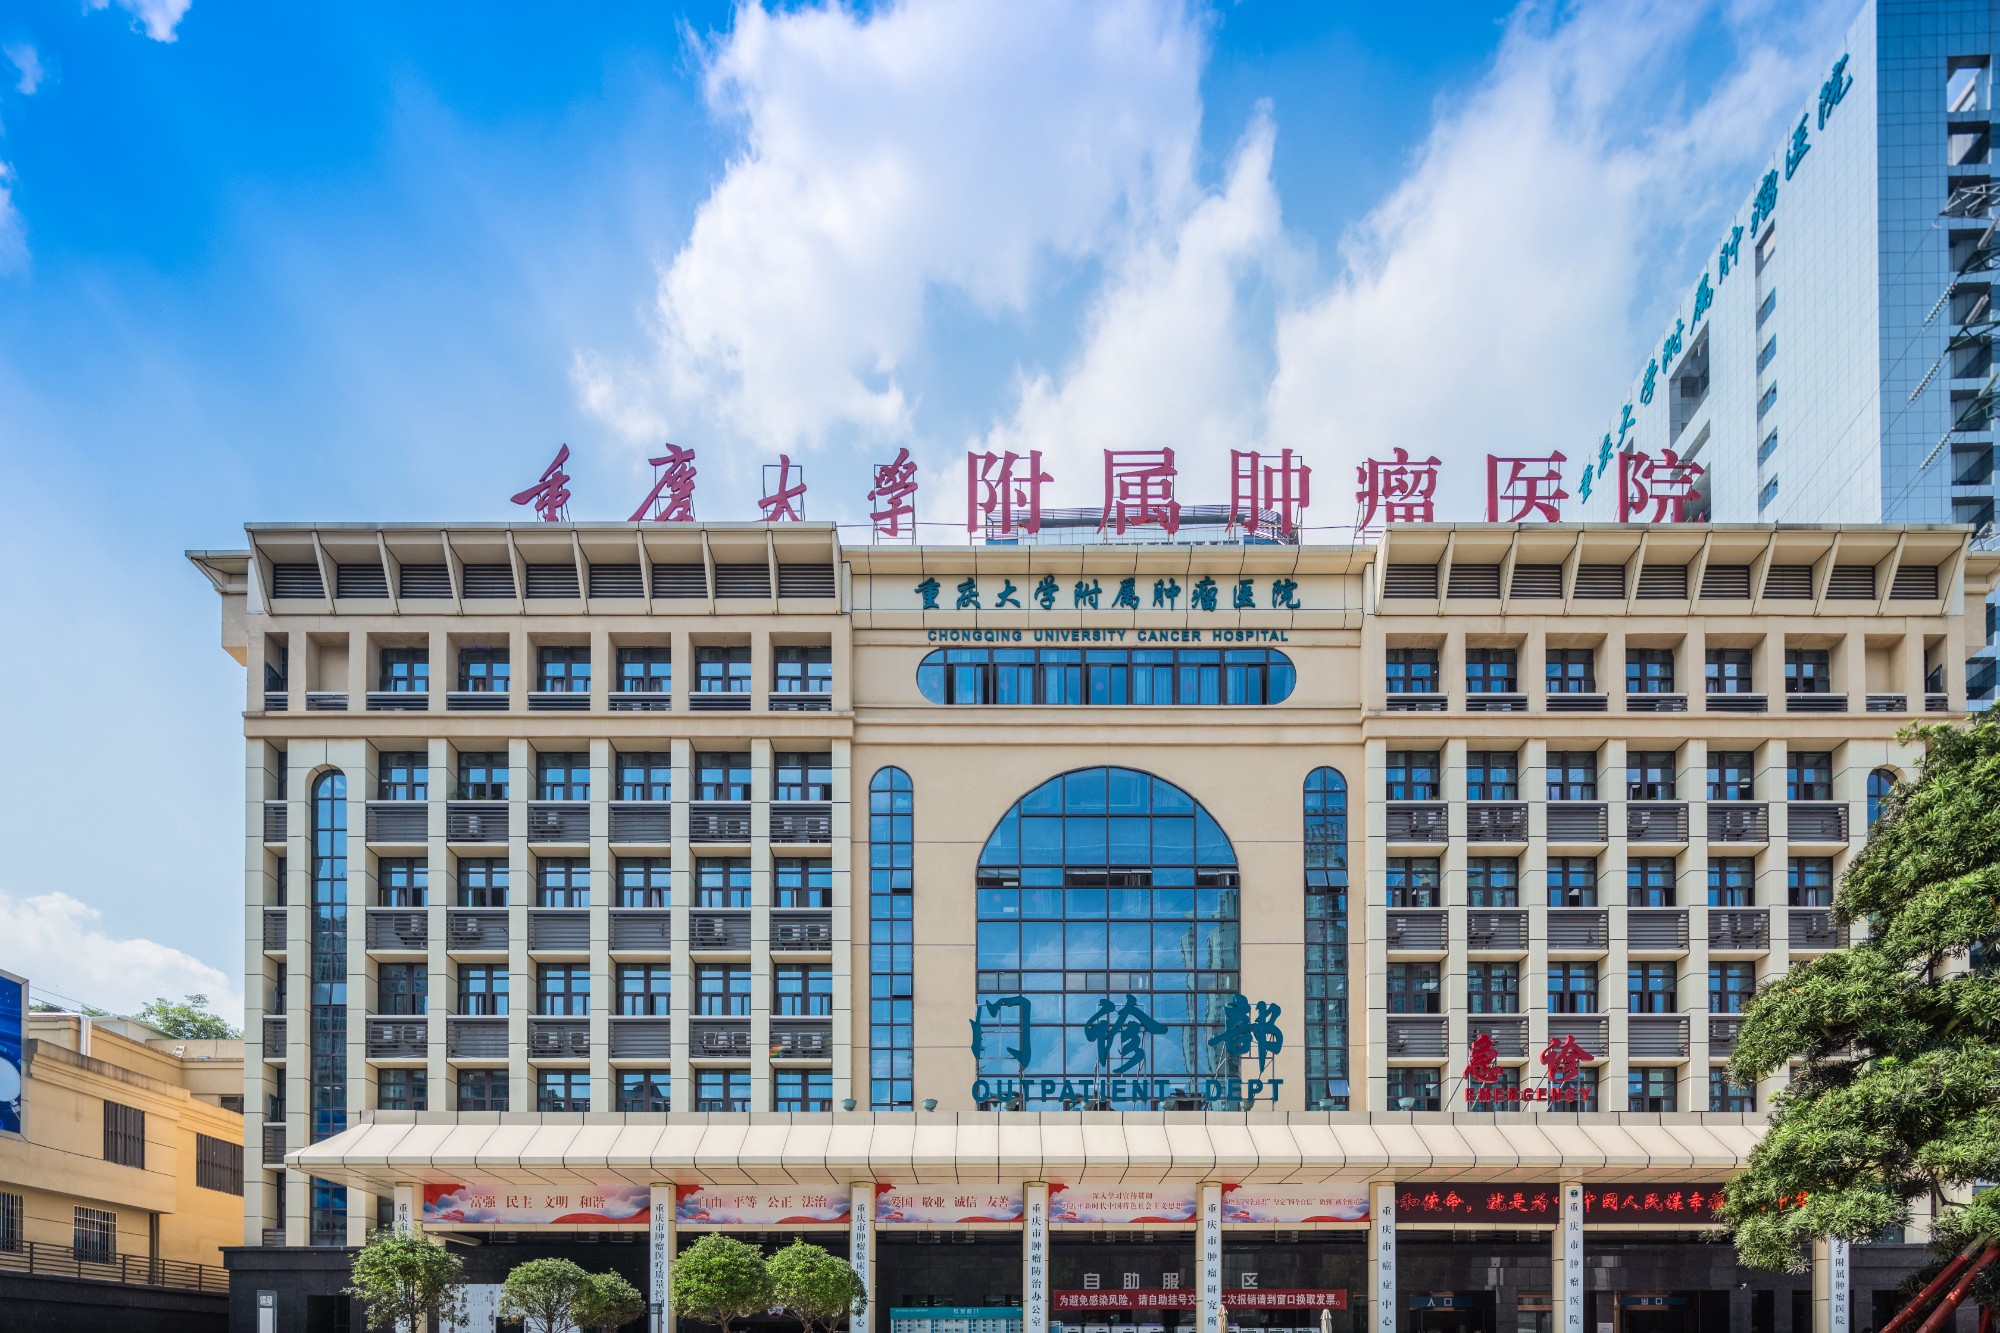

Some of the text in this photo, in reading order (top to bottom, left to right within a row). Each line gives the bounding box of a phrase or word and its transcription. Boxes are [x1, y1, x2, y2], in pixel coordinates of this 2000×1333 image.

[914, 574, 1301, 612] 重庆大学附属肿瘤医院
[927, 629, 1289, 642] CHONGQING UNIVERSITY CANCER HOSPITAL
[969, 993, 1285, 1074] 门诊部
[1463, 1034, 1594, 1083] 急诊
[971, 1079, 1284, 1103] OUTPATIENT DEPT
[1464, 1087, 1592, 1102] EMERGENCY
[469, 1195, 606, 1209] 富强 民主 文明 和谐
[699, 1195, 827, 1209] 自由 平等 公正 法治
[889, 1195, 1010, 1209] 爱国 敬业 诚信 友善
[1382, 1206, 1393, 1326] 重庆市癌症中心
[1569, 1203, 1580, 1325] 重庆市肿瘤医院
[1083, 1272, 1258, 1290] 自助服区
[1427, 1298, 1452, 1307] 入口
